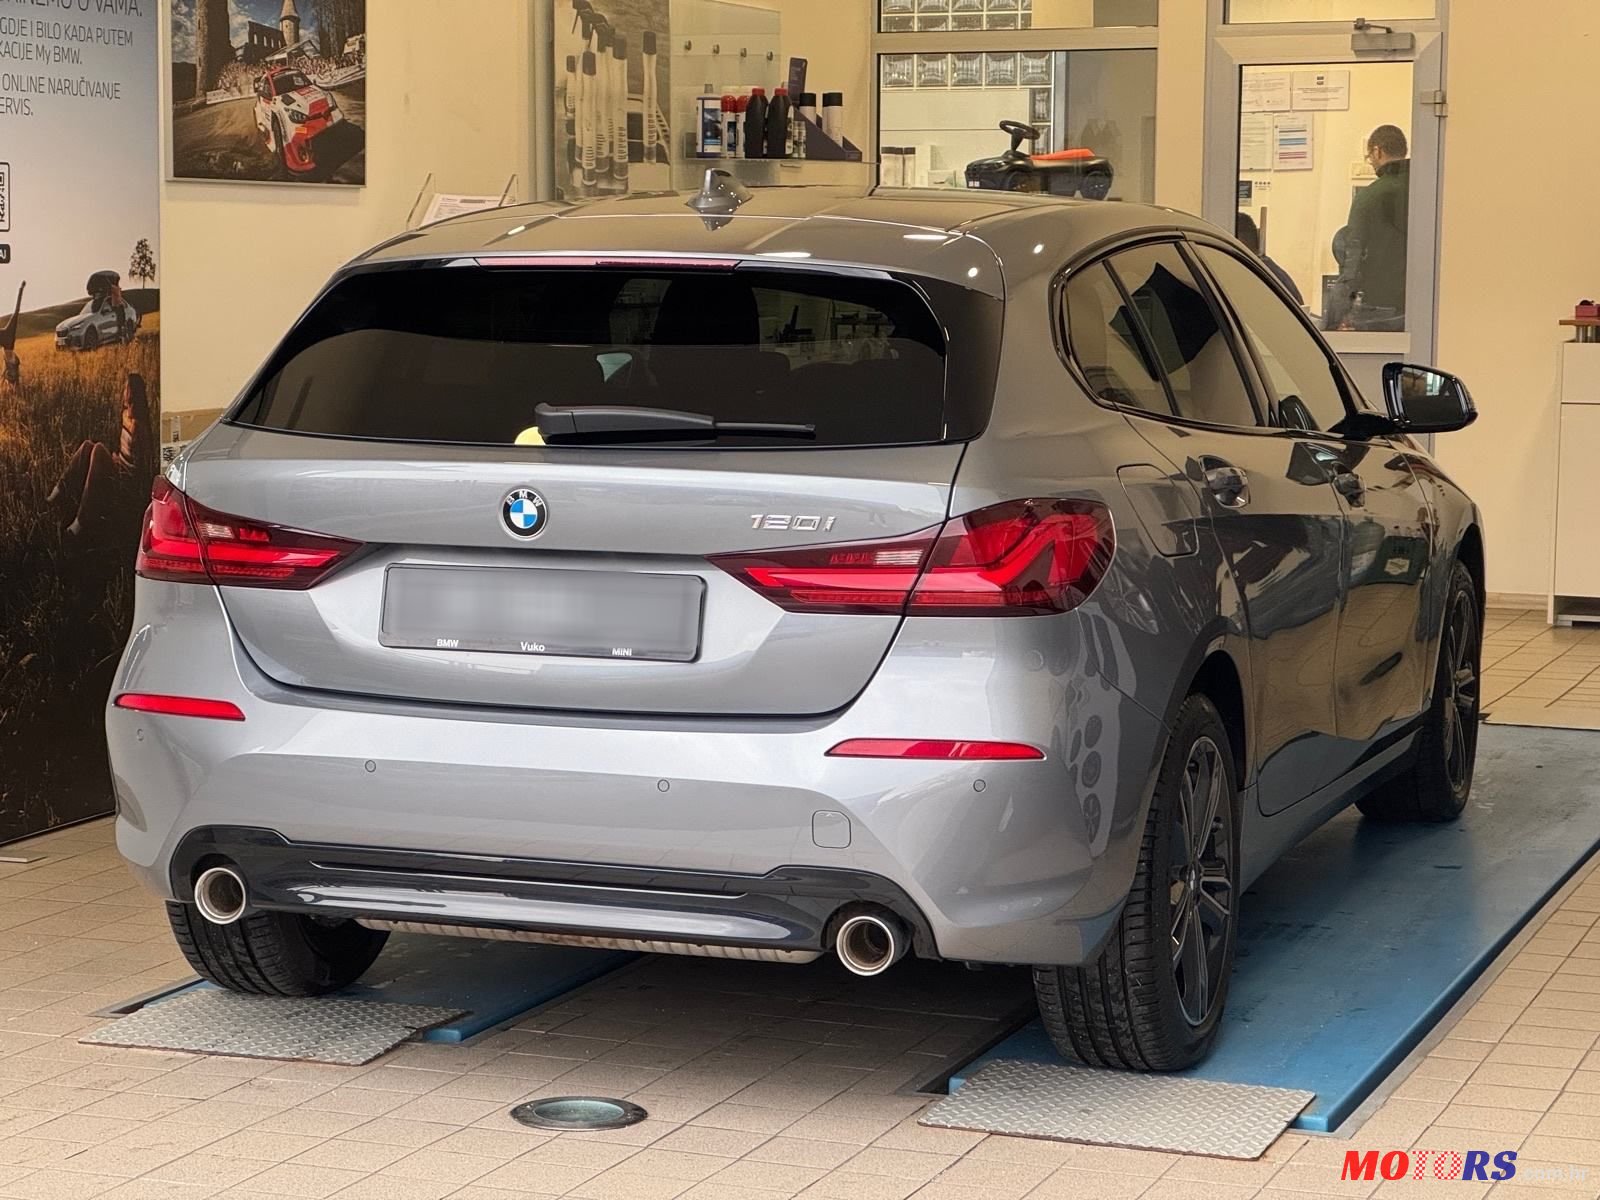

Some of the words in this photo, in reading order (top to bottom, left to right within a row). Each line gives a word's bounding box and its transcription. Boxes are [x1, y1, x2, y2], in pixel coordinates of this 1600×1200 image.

[36, 20, 62, 40] BILO
[64, 23, 94, 43] KADA
[95, 27, 133, 47] PUTEM
[35, 44, 51, 64] My
[53, 45, 83, 65] BMW.
[2, 73, 46, 94] ONLINE
[47, 76, 121, 100] NARUČIVANJE
[506, 489, 544, 507] BMW
[750, 514, 837, 533] 120i
[436, 638, 460, 648] BMW
[520, 641, 545, 652] Vuko
[611, 647, 632, 657] MINI
